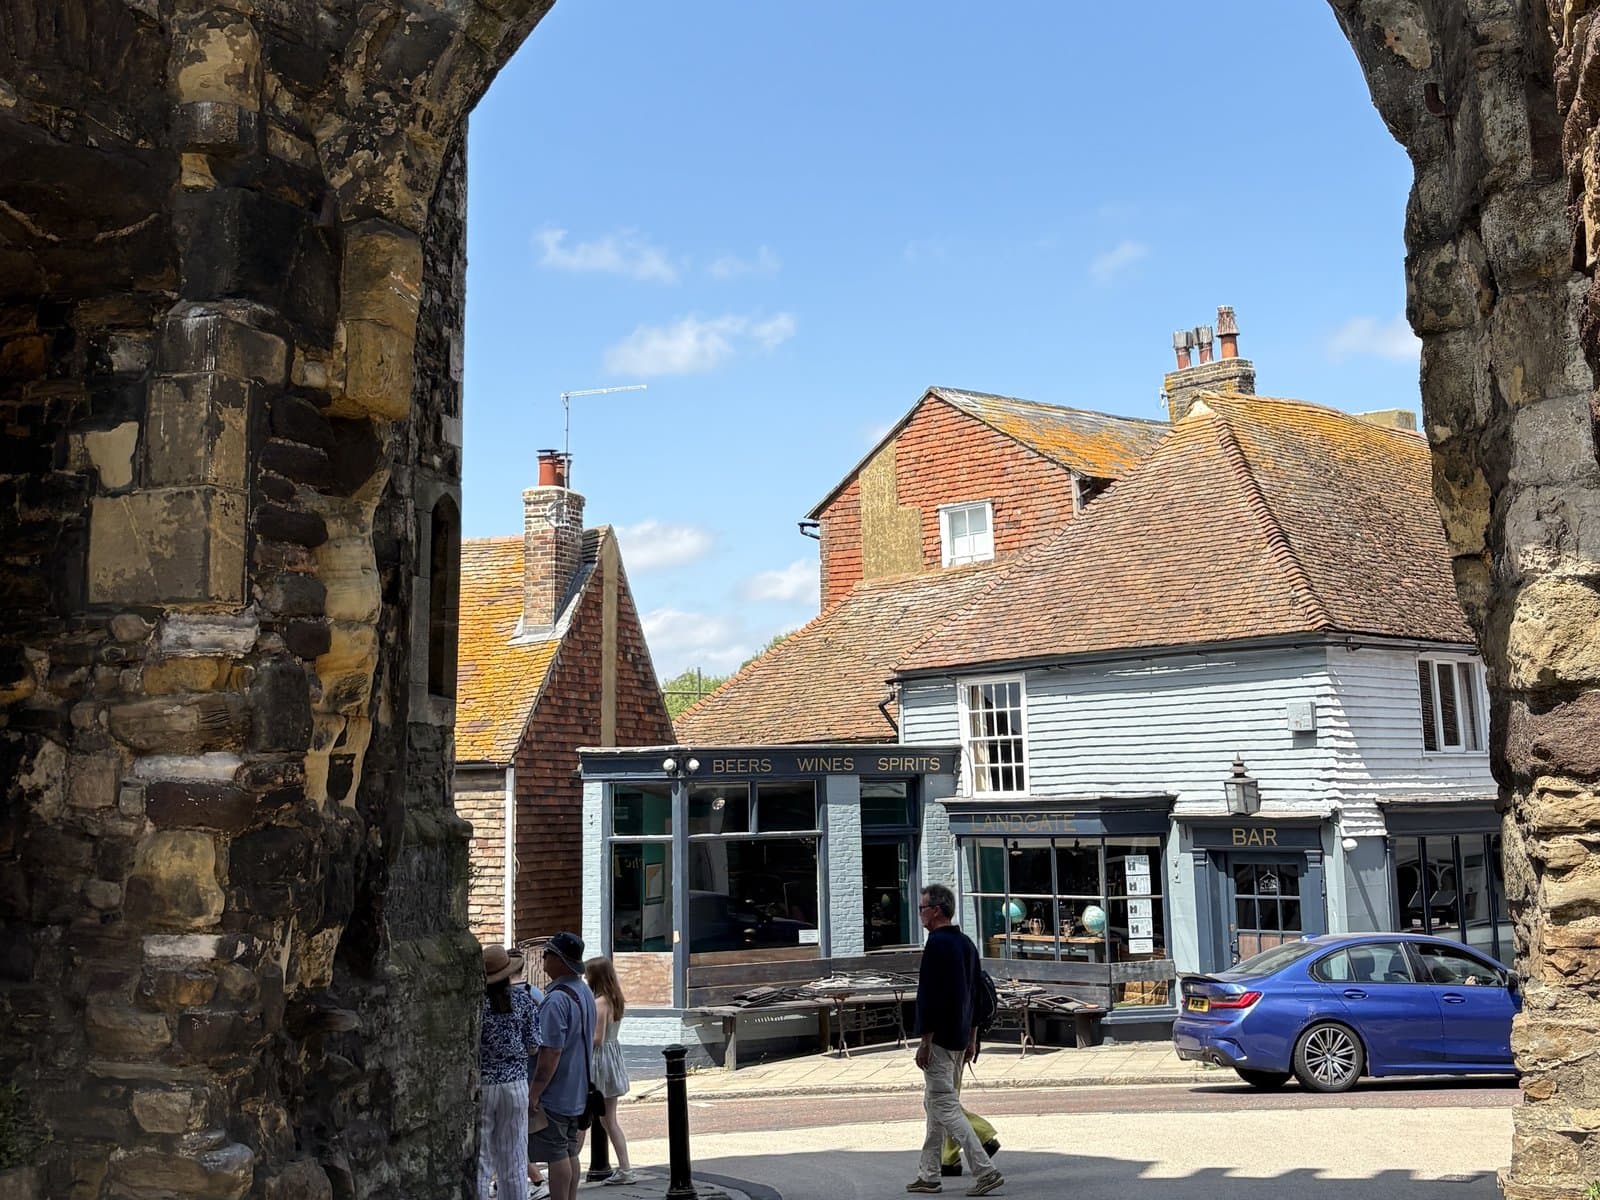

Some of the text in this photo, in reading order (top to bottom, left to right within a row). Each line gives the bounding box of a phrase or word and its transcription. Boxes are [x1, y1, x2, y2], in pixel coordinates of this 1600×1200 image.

[712, 757, 941, 773] BEERS WINES SPIRITS
[971, 813, 1077, 833] LANDGATE
[1231, 828, 1278, 846] BAR
